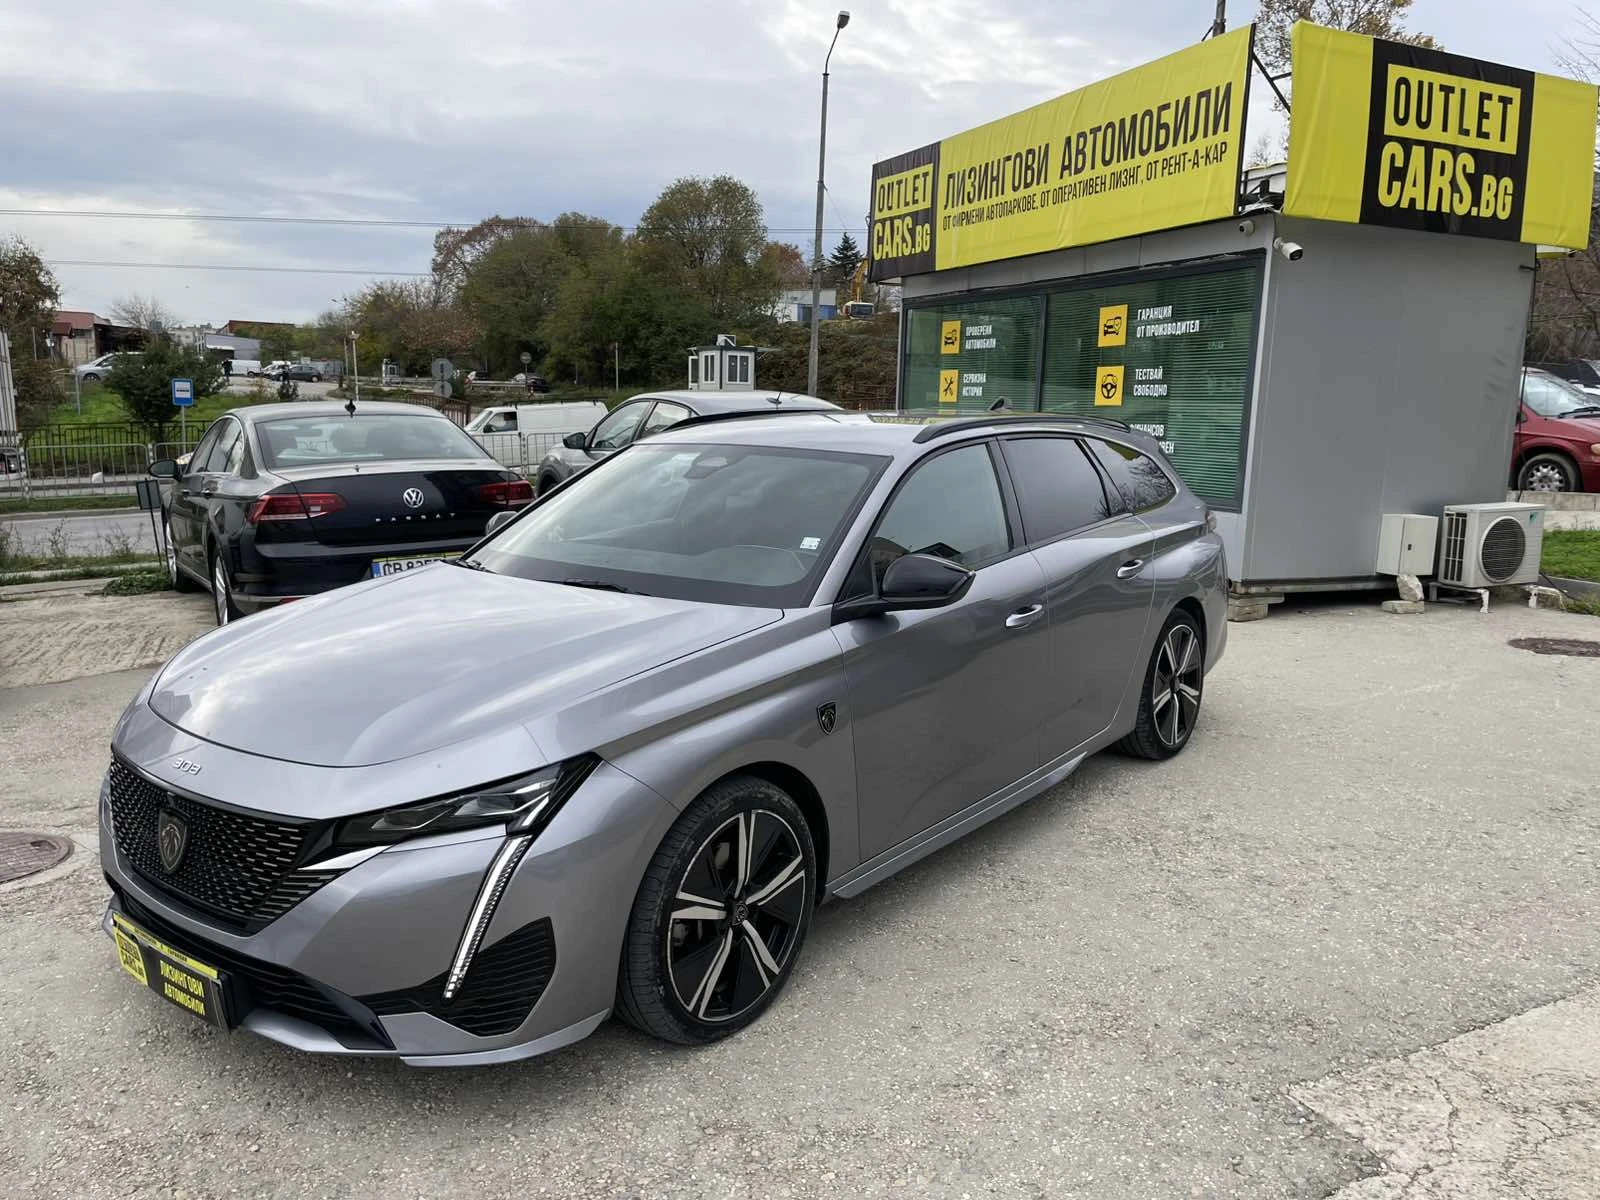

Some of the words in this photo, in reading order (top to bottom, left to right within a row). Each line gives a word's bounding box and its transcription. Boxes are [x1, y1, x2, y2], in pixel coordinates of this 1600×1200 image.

[1393, 76, 1513, 142] OUTLET
[944, 143, 1050, 210] ЛИЗИНГОВИ
[1059, 81, 1233, 179] АВТОМОБИЛИ
[878, 171, 929, 212] OUTLET
[942, 215, 951, 231] ОТ
[1040, 190, 1051, 208] ОТ
[1052, 176, 1106, 205] ОПЕРАТИВЕН
[1146, 159, 1159, 181] ОТ
[1161, 141, 1227, 178] РЕНТ-А-КАР
[1378, 141, 1513, 220] CARS.BG
[873, 216, 930, 261] CARS.BG
[1136, 325, 1145, 338] ОТ
[1146, 319, 1200, 337] ПРОИЗВОДИТЕЛ
[1137, 305, 1173, 321] ГАРАНЦИЯ
[1133, 384, 1168, 397] СВОБОДНО
[1135, 366, 1163, 380] ТЕСТВАЙ
[172, 757, 201, 775] 308
